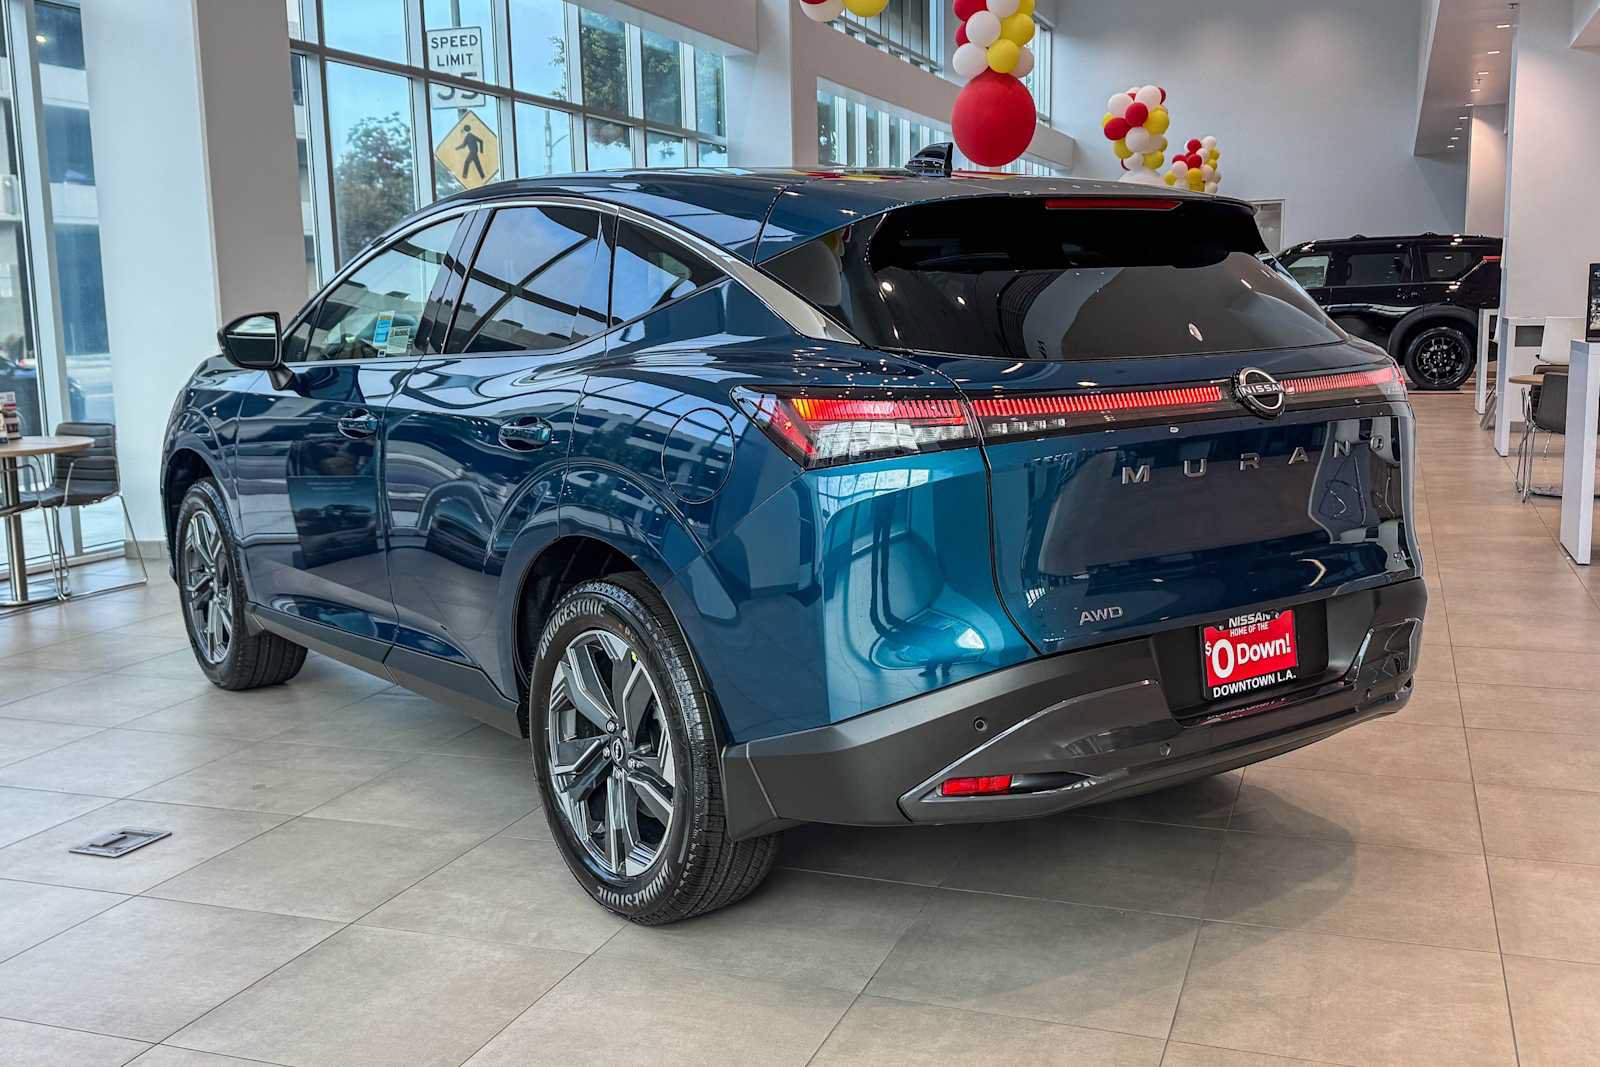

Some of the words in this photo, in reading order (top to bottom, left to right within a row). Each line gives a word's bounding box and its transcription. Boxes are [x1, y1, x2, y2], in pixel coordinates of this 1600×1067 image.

[431, 34, 478, 49] SPEED
[436, 53, 473, 67] LIMIT
[1241, 383, 1285, 395] NISSAN
[1121, 434, 1384, 485] MURANO
[1079, 606, 1123, 626] AWD
[1228, 612, 1270, 628] NISSAN
[539, 599, 605, 660] BRIDGESTONE
[1229, 627, 1248, 637] HOME
[1248, 624, 1257, 634] OF
[1257, 621, 1269, 631] THE
[1236, 633, 1291, 665] Down!
[1213, 673, 1275, 698] DOWNTOWN
[1277, 669, 1297, 683] L.A.
